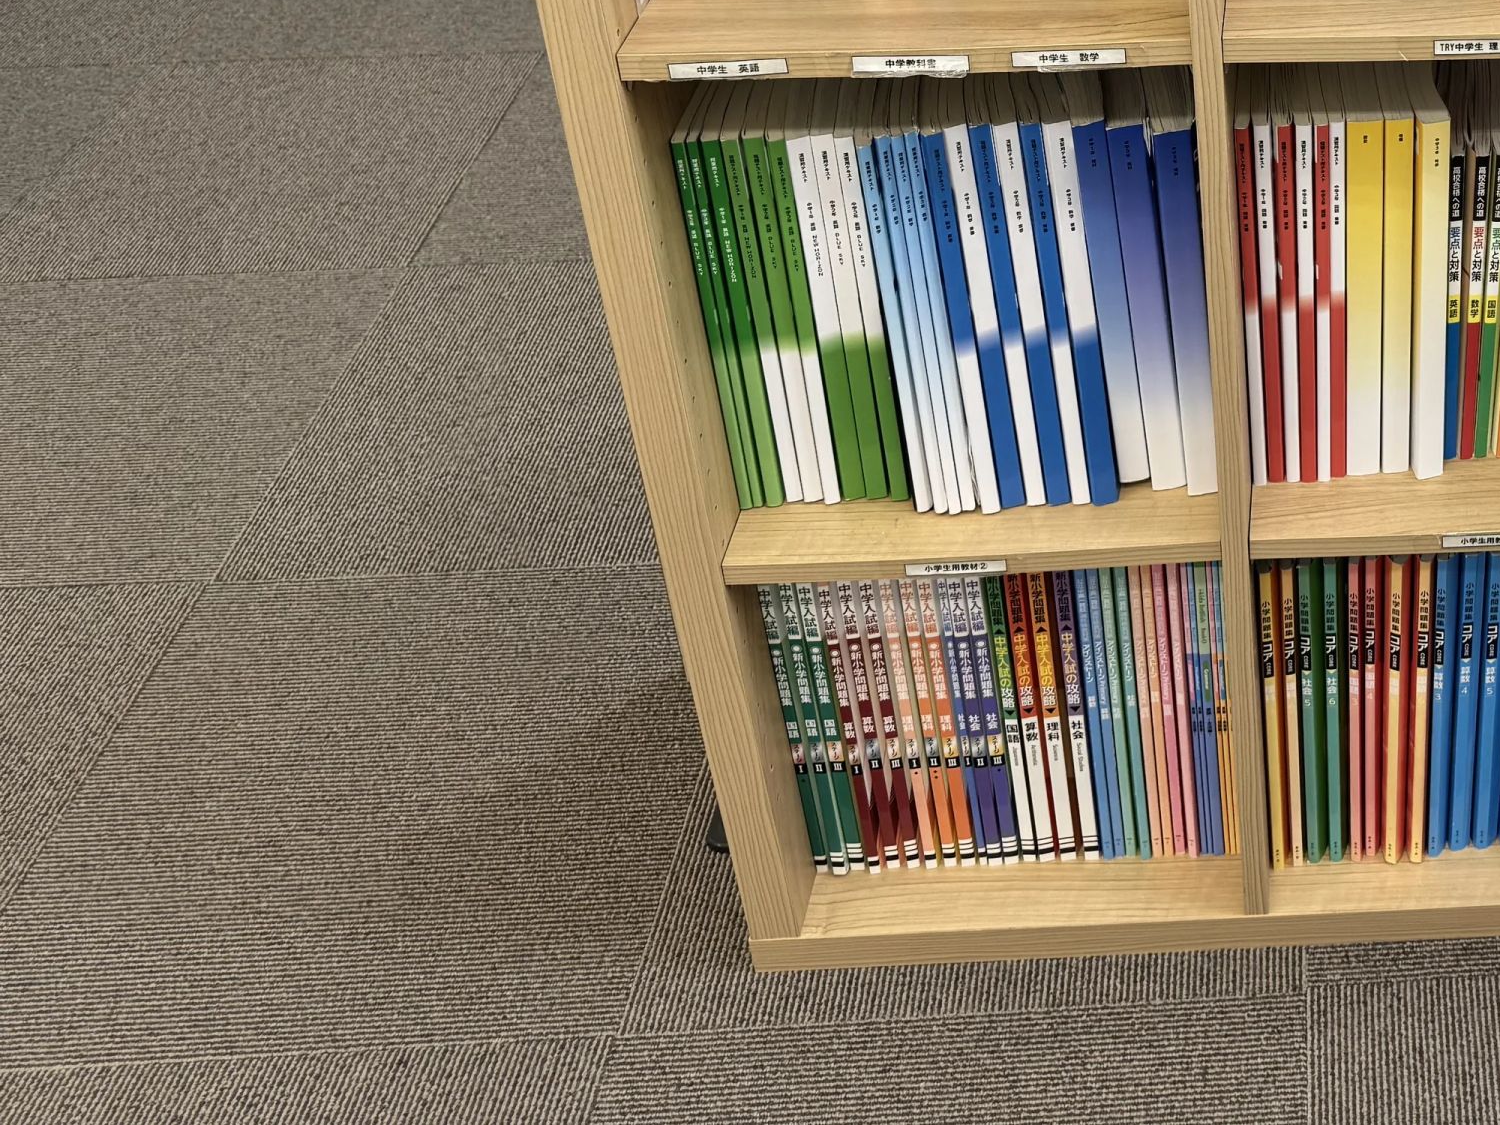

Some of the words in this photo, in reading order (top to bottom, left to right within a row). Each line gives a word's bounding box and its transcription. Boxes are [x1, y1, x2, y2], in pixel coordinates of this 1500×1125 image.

[1439, 41, 1484, 54] TRY中学生
[1038, 52, 1069, 65] 中学生
[1079, 51, 1100, 63] 数学
[697, 63, 730, 75] 中学生
[738, 62, 760, 74] 英語
[1449, 226, 1460, 283] 要点と対策
[1471, 225, 1485, 283] 要点と対策
[1449, 298, 1458, 318] 英語
[924, 562, 988, 573] 小学生用教材②
[1061, 632, 1080, 705] 中学入試の攻略
[1047, 721, 1060, 741] 理科
[1071, 721, 1084, 740] 社会
